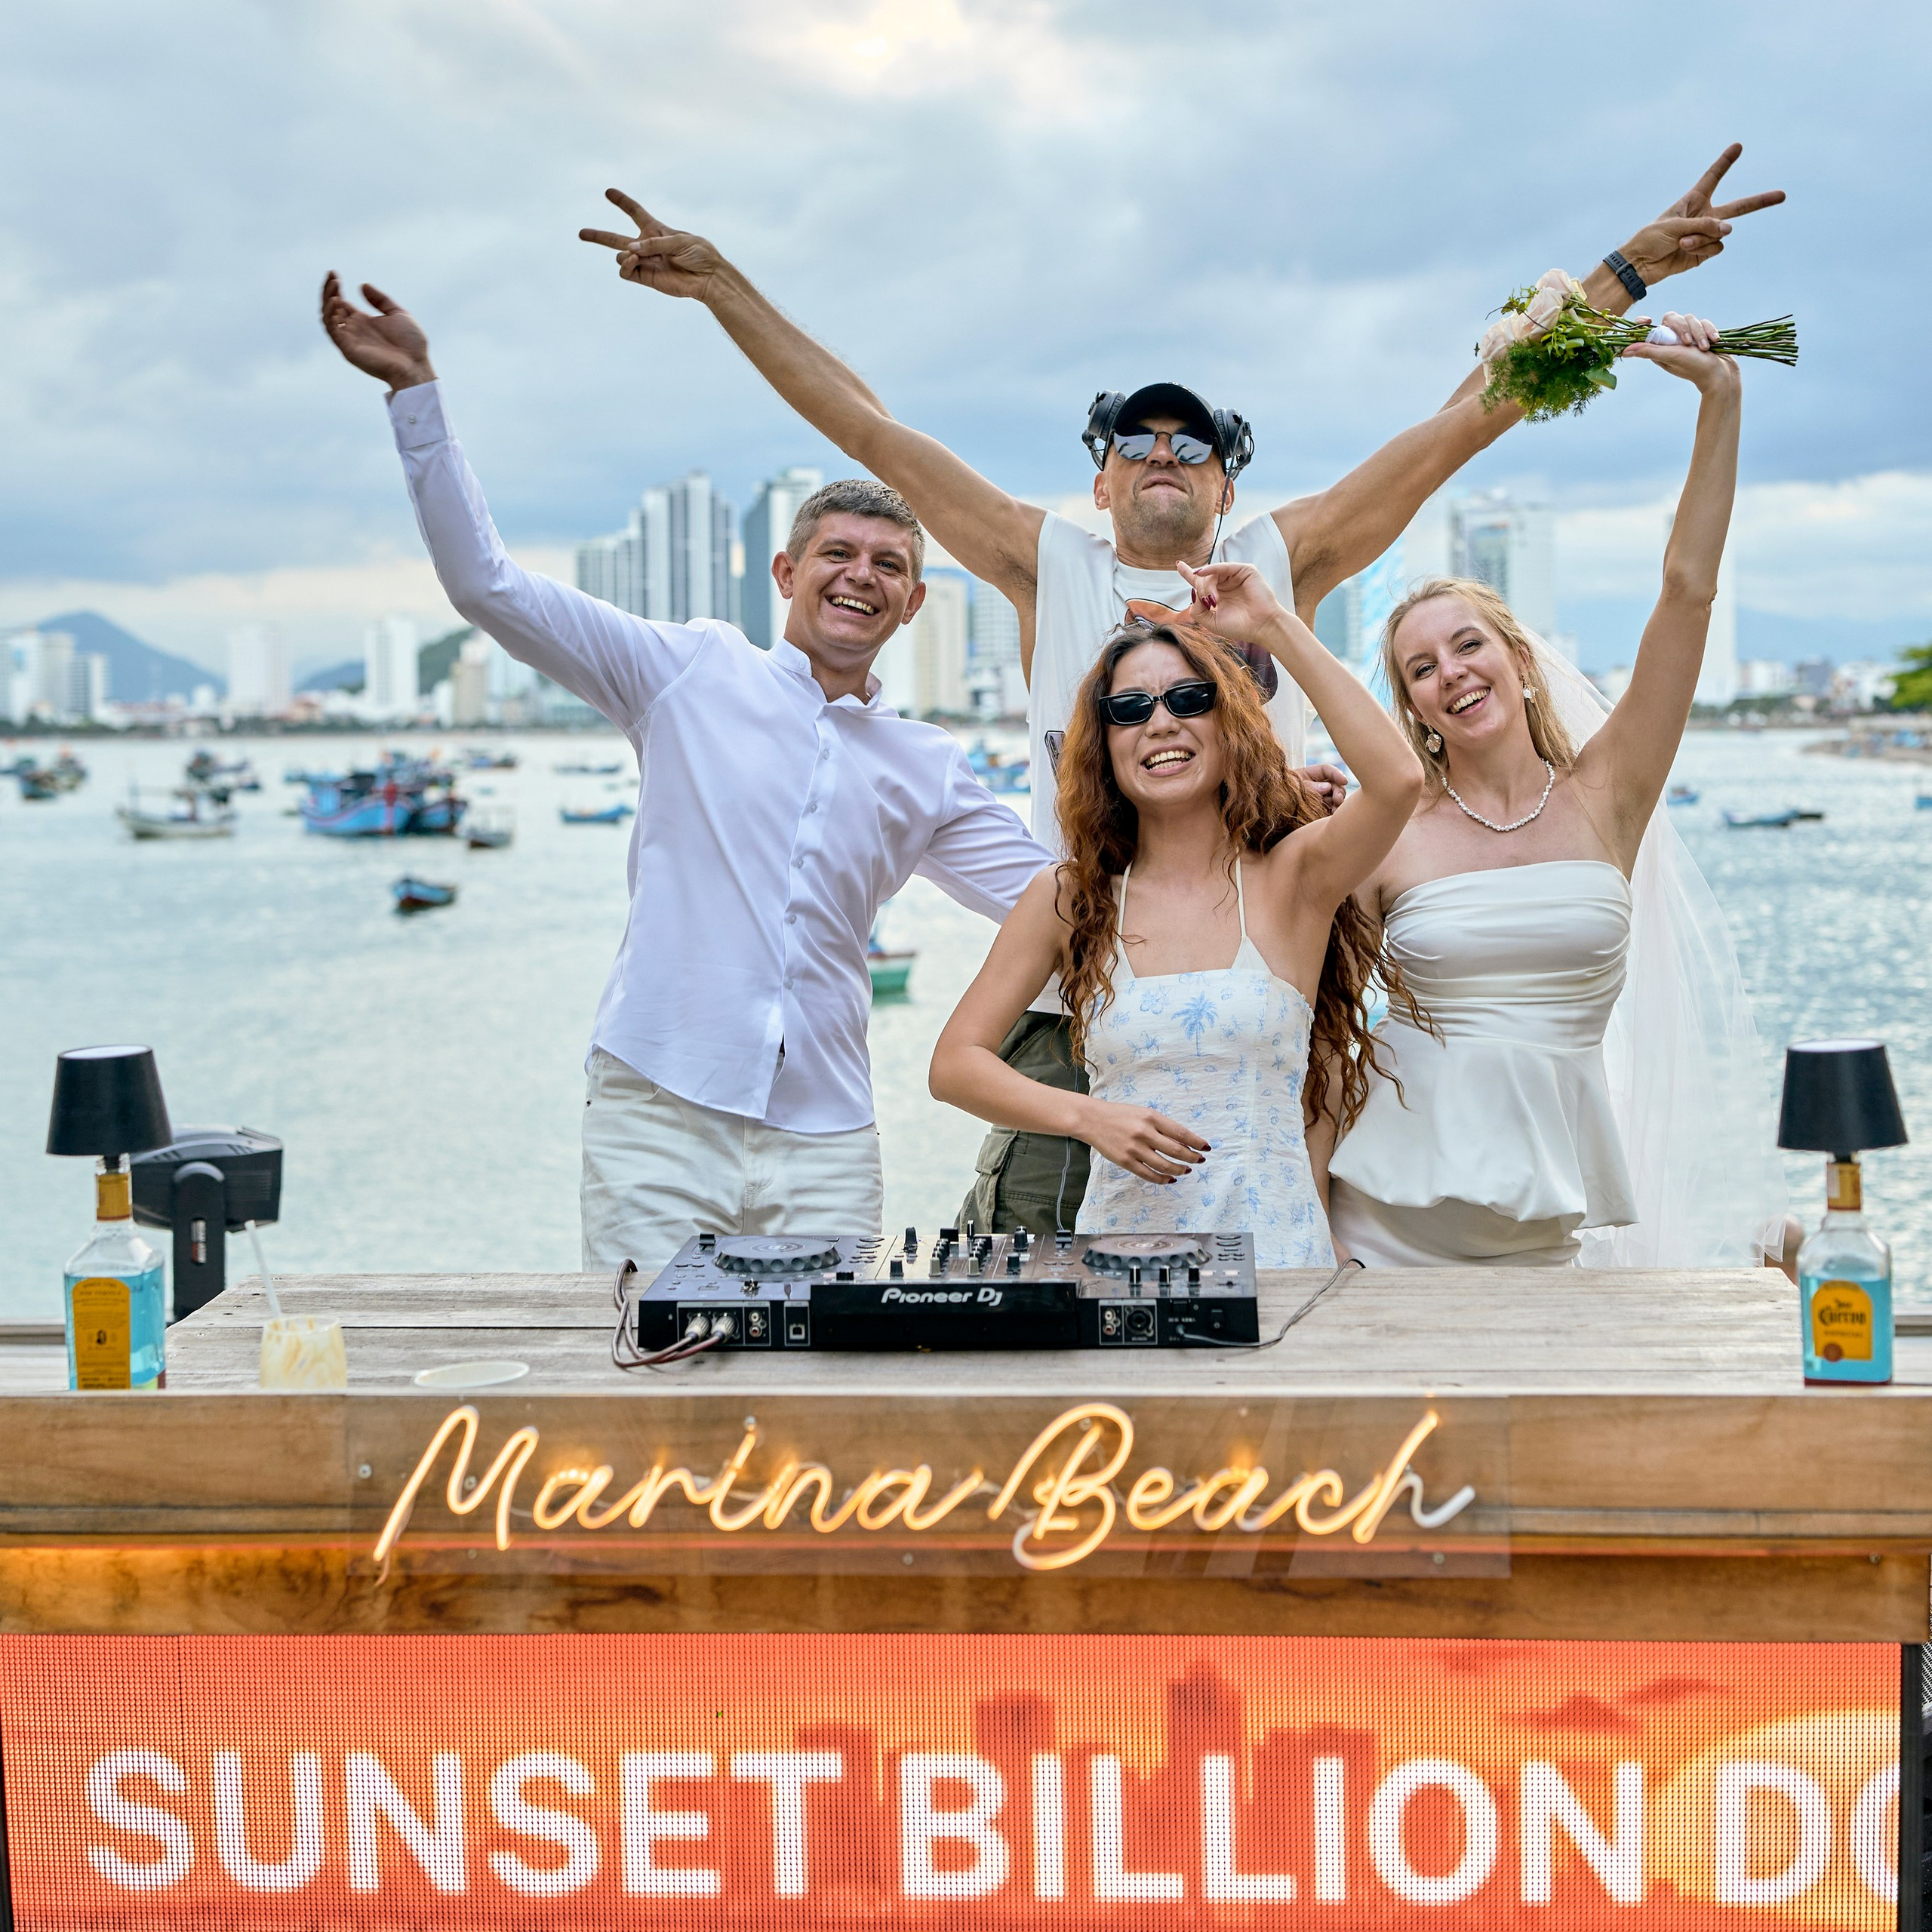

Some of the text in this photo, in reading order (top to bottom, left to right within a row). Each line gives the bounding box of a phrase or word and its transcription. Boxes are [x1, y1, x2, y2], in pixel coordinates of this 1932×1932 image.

[881, 1287, 973, 1303] Pioneer
[373, 1402, 1475, 1571] Marina Beach
[84, 1748, 844, 1900] SUNSET
[903, 1752, 1644, 1908] BILLION
